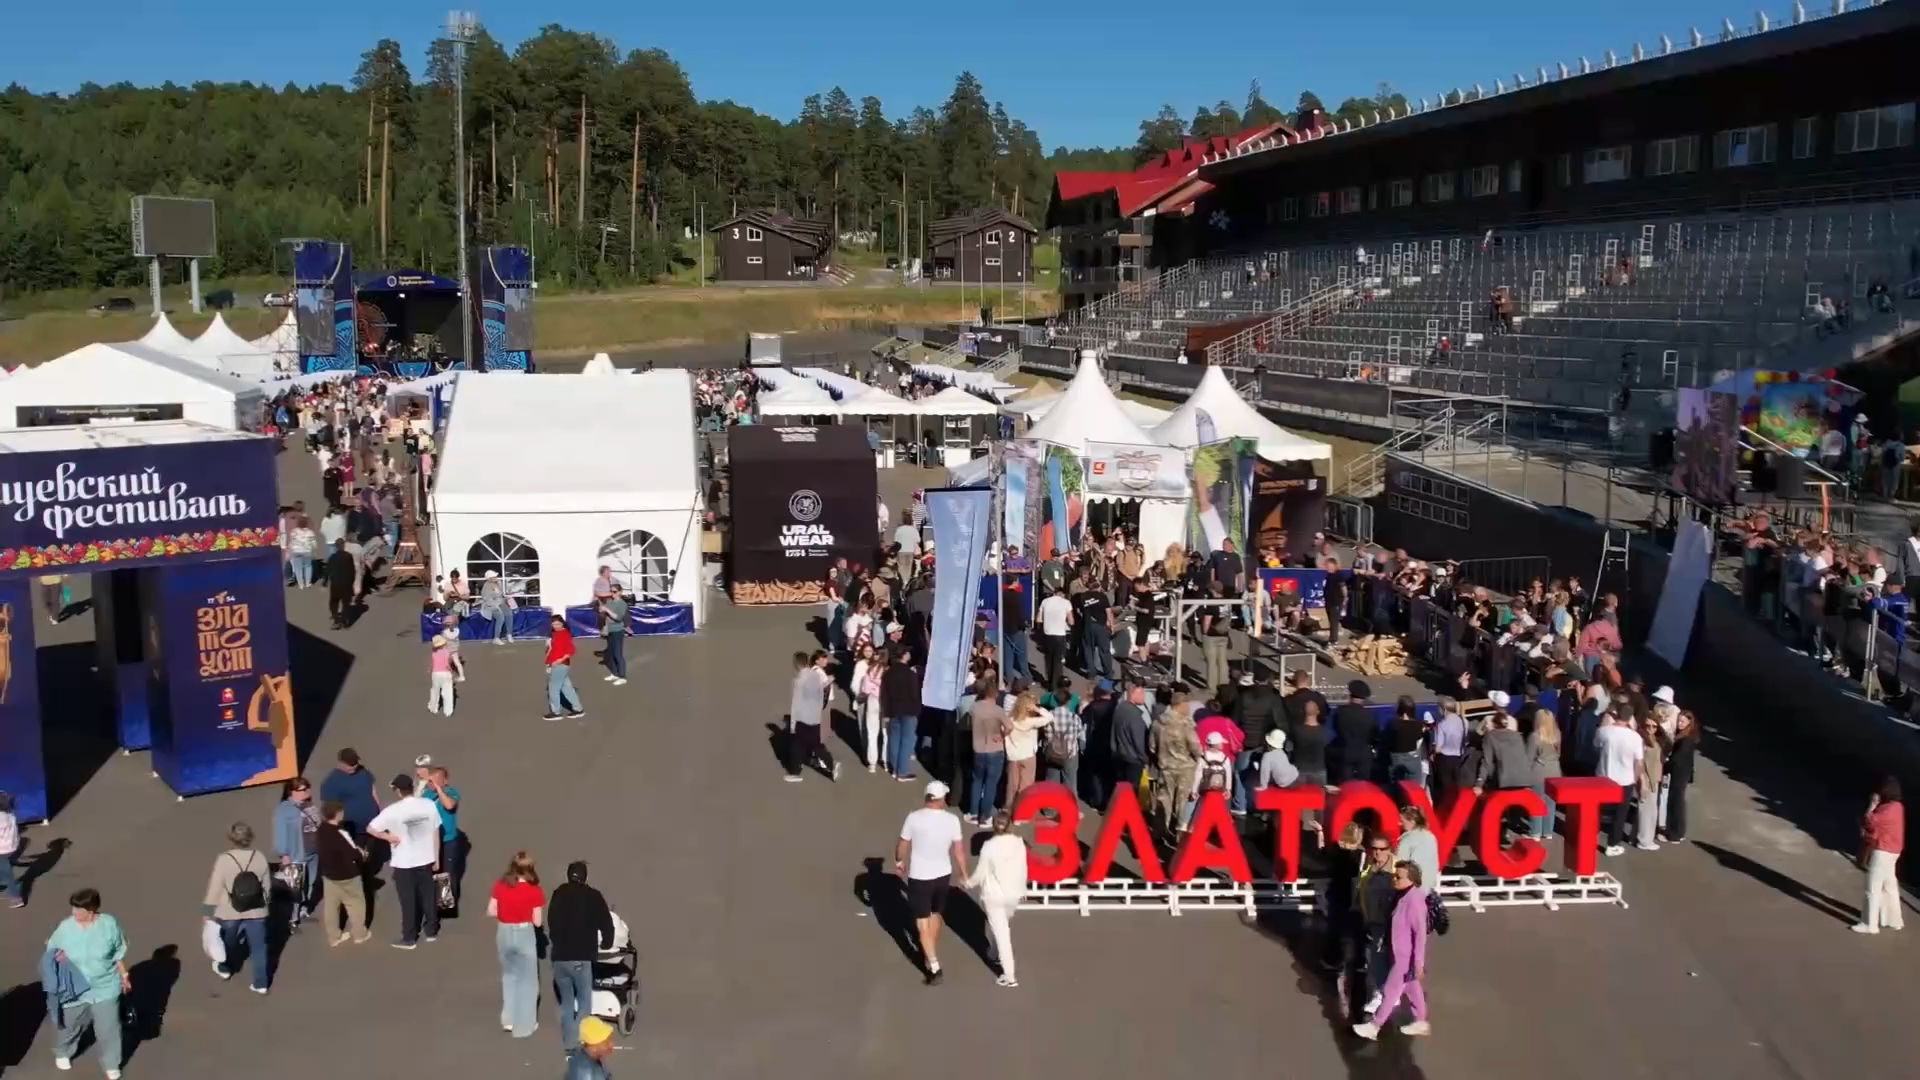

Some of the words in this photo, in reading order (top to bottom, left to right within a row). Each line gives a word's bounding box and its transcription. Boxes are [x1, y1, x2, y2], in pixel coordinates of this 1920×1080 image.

[732, 228, 740, 240] 3
[1008, 231, 1016, 243] 2
[43, 482, 250, 539] фестиваль
[781, 524, 831, 536] URAL
[778, 535, 835, 546] WEAR
[1012, 776, 1625, 885] ЗЛАТОУСТ
